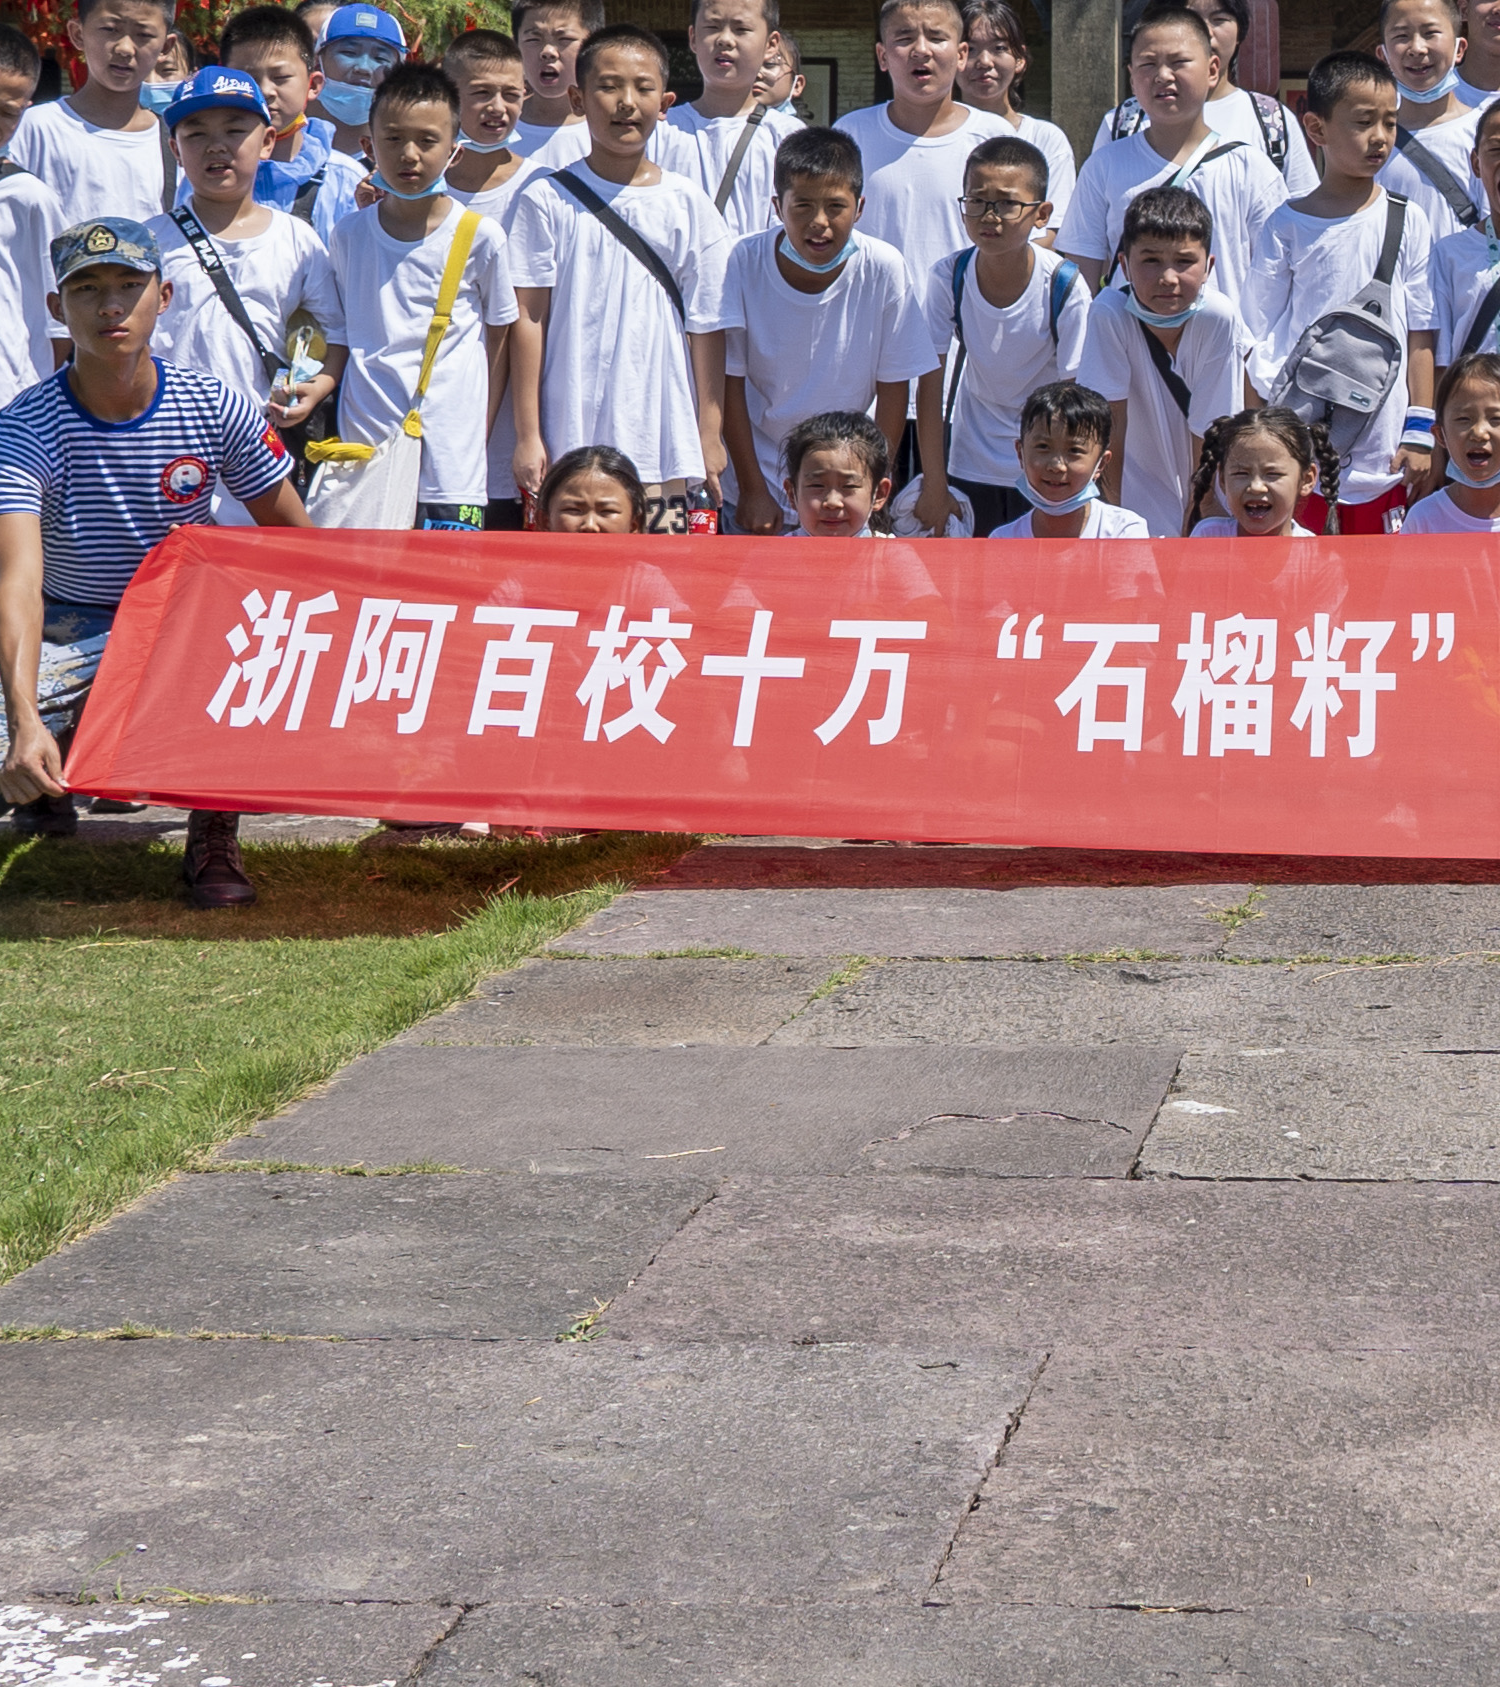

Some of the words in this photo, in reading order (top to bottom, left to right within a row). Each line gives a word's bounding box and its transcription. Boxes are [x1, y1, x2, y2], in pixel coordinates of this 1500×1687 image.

[646, 494, 688, 534] 23
[206, 589, 928, 749] 浙阿百校十万
[996, 611, 1456, 759] “石榴籽”
